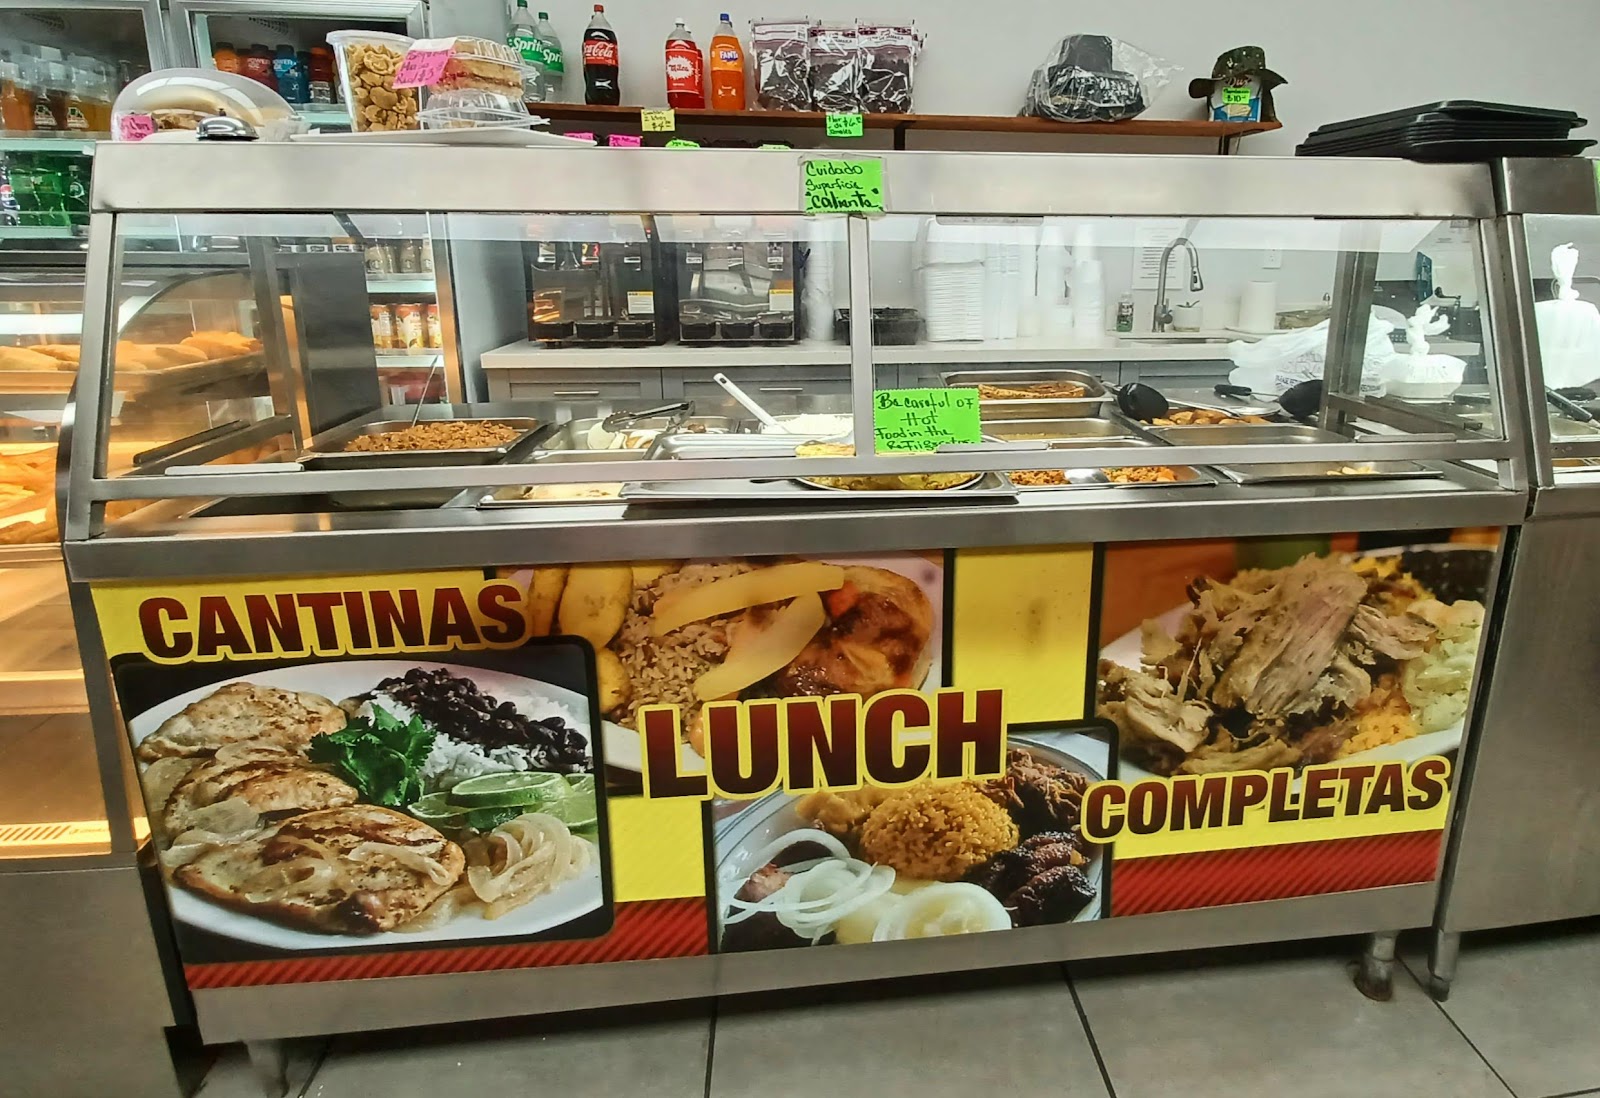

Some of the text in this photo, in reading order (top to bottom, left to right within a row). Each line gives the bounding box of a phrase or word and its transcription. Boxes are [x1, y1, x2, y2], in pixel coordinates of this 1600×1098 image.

[806, 160, 863, 176] Cuidado
[900, 410, 938, 426] Hot
[906, 429, 922, 438] in
[924, 425, 953, 437] the
[138, 583, 527, 658] CANTINAS
[644, 688, 1004, 799] LUNCH
[1085, 759, 1446, 839] COMPLETAS
